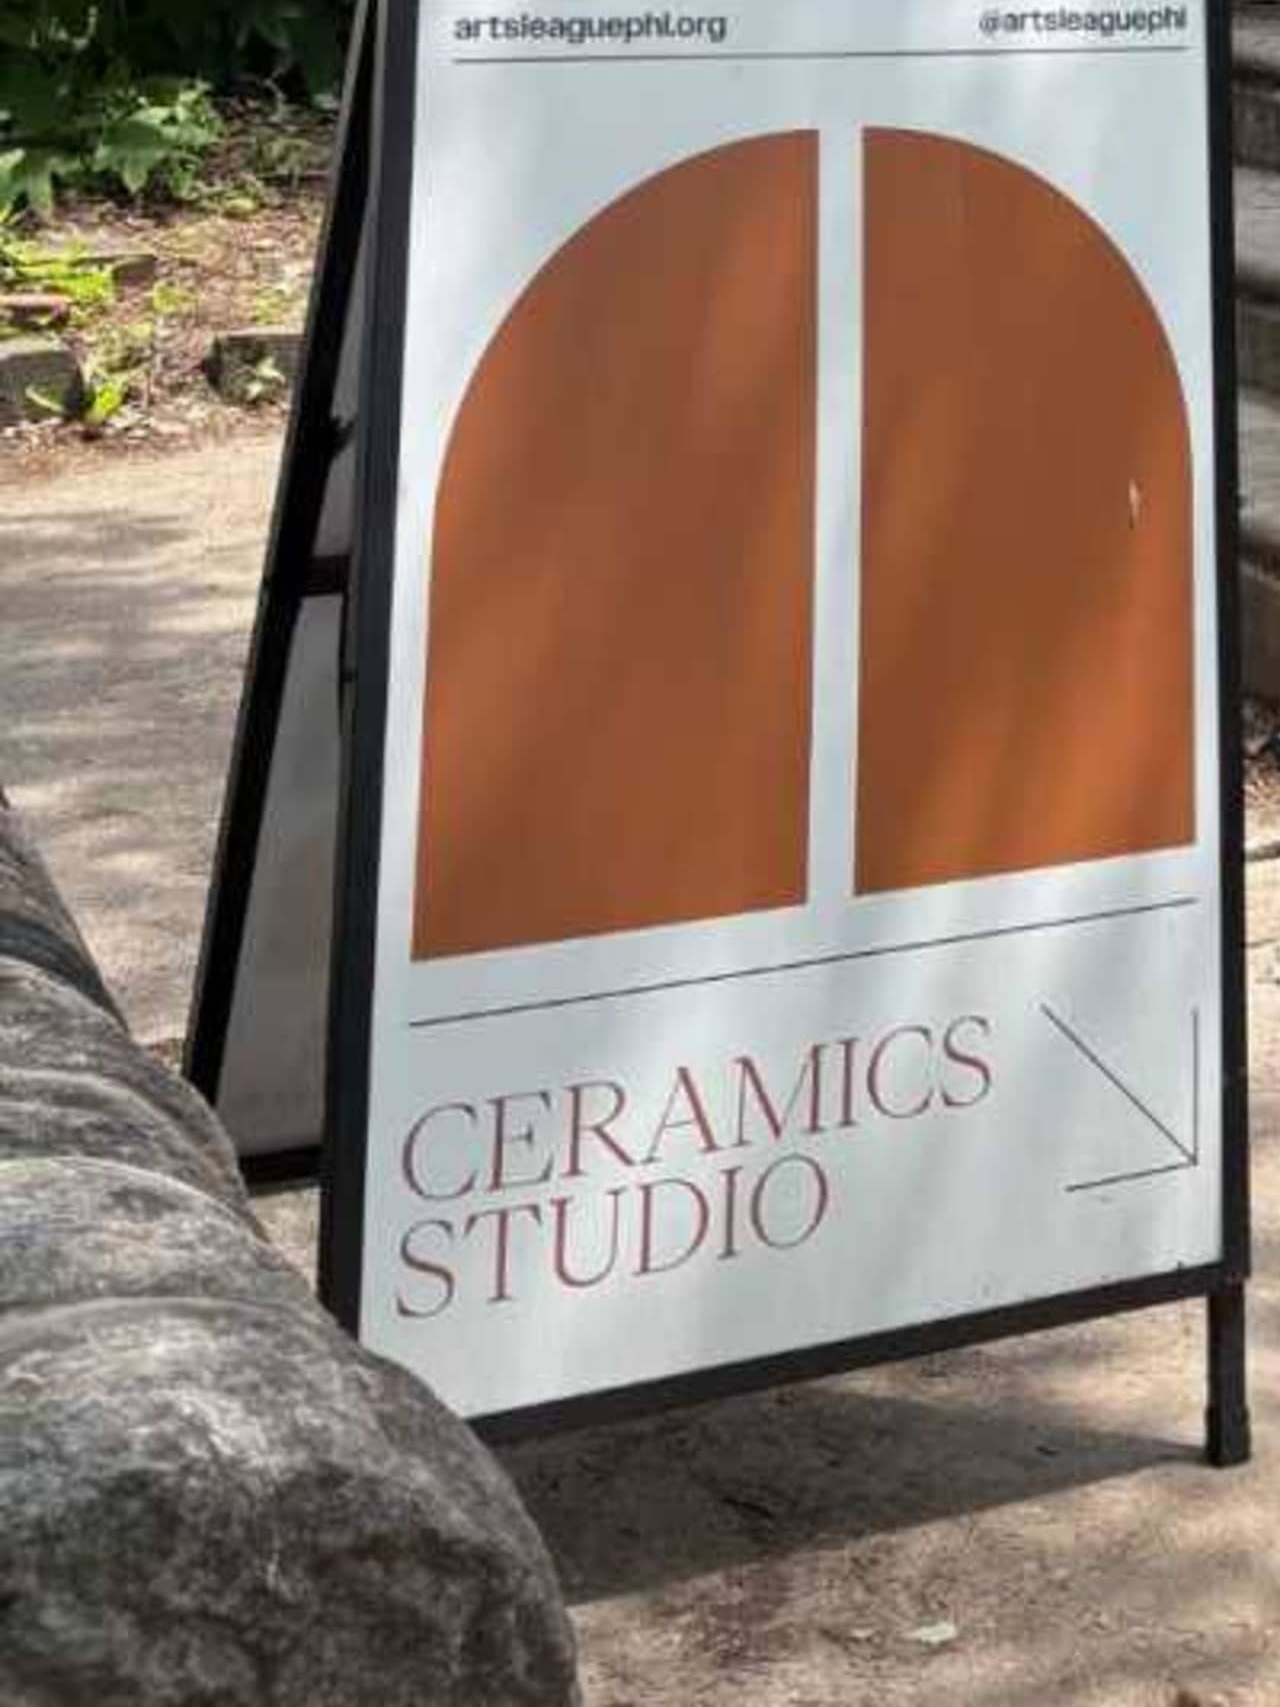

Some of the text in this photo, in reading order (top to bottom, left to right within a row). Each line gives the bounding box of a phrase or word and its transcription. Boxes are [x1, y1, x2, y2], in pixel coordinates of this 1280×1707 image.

[453, 11, 728, 44] artsleaguephl.org
[400, 1014, 995, 1204] CERAMICS
[396, 1152, 830, 1320] STUDIO
